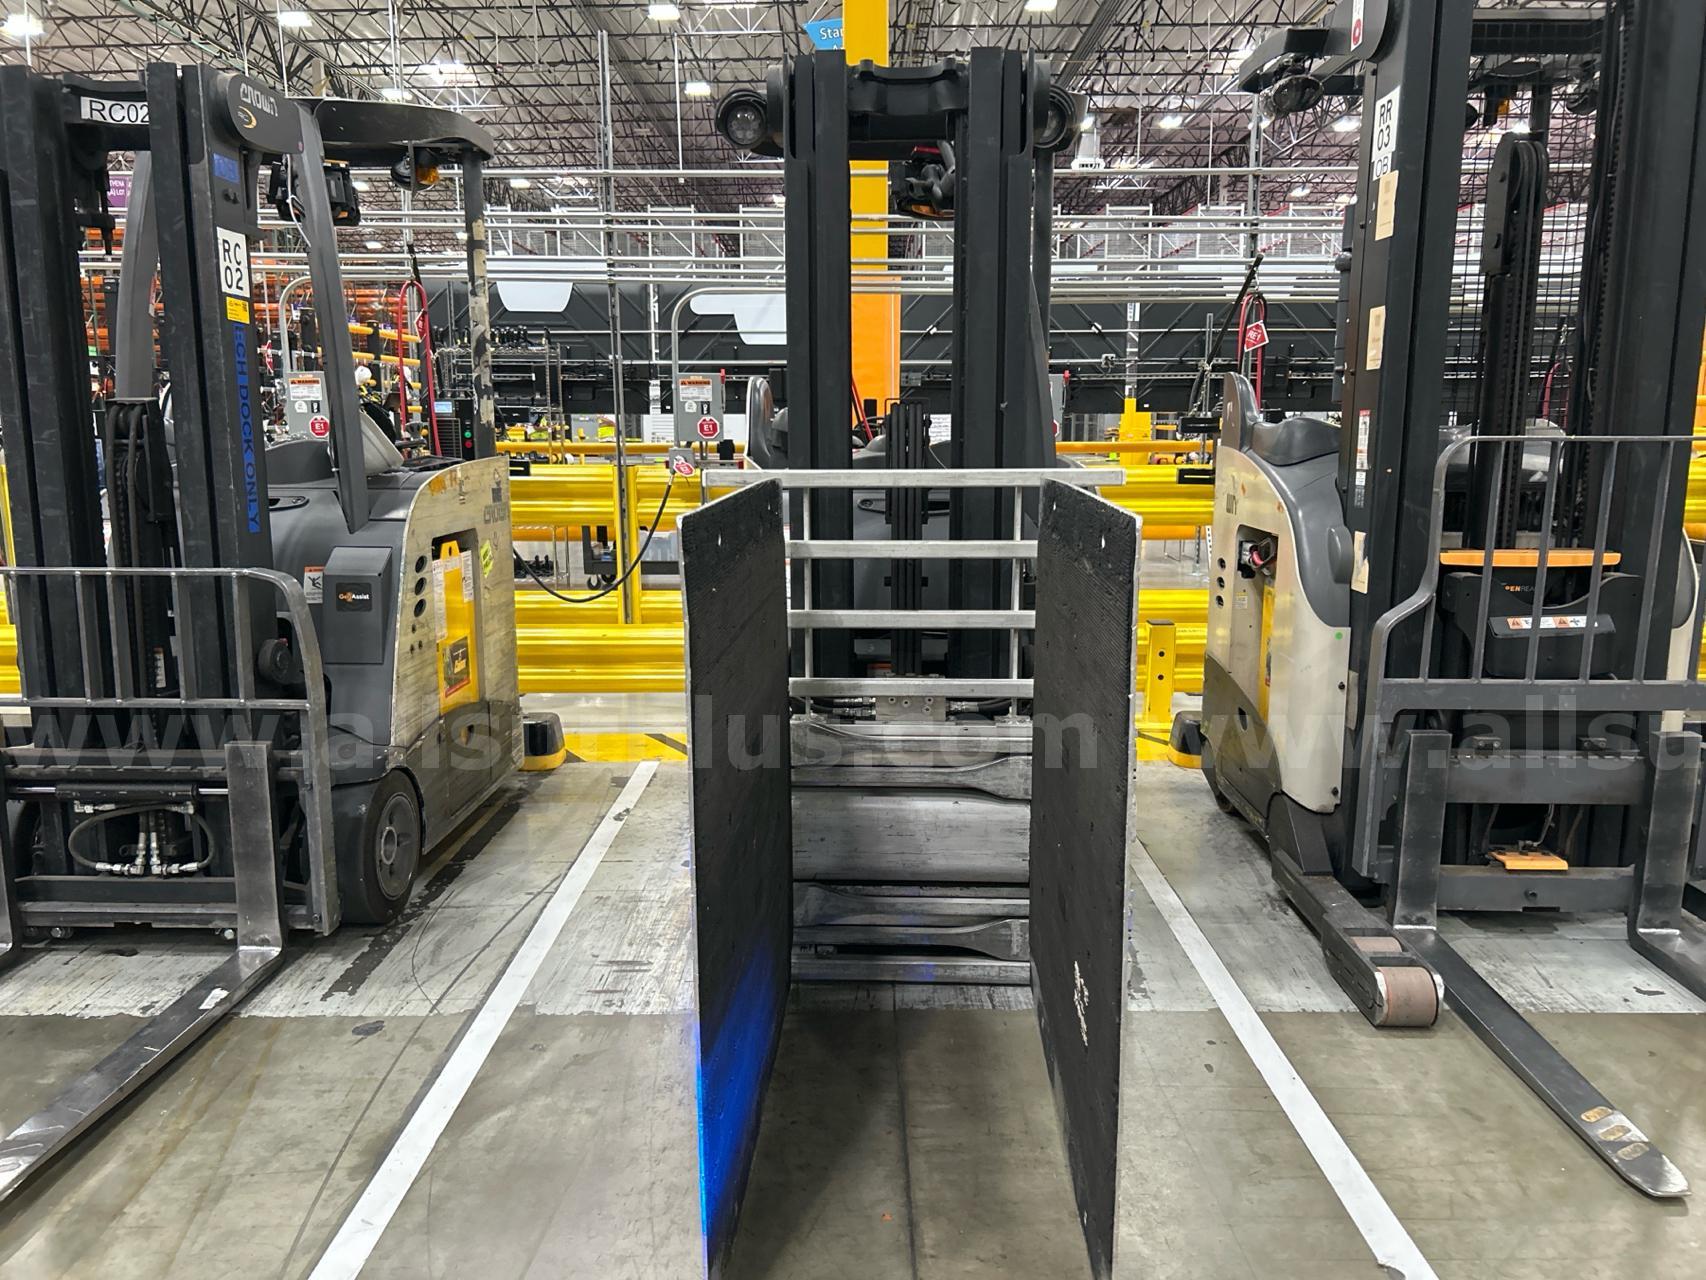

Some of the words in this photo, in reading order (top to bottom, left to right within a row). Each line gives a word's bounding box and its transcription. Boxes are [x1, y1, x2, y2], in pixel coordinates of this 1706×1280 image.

[89, 99, 149, 123] RC02
[240, 82, 279, 117] CROWN
[1378, 99, 1393, 128] RR
[1377, 125, 1391, 151] 03
[222, 238, 242, 266] RC
[224, 265, 244, 291] 02
[703, 424, 713, 432] E1
[239, 384, 253, 454] DOCK
[246, 462, 261, 527] ONLY
